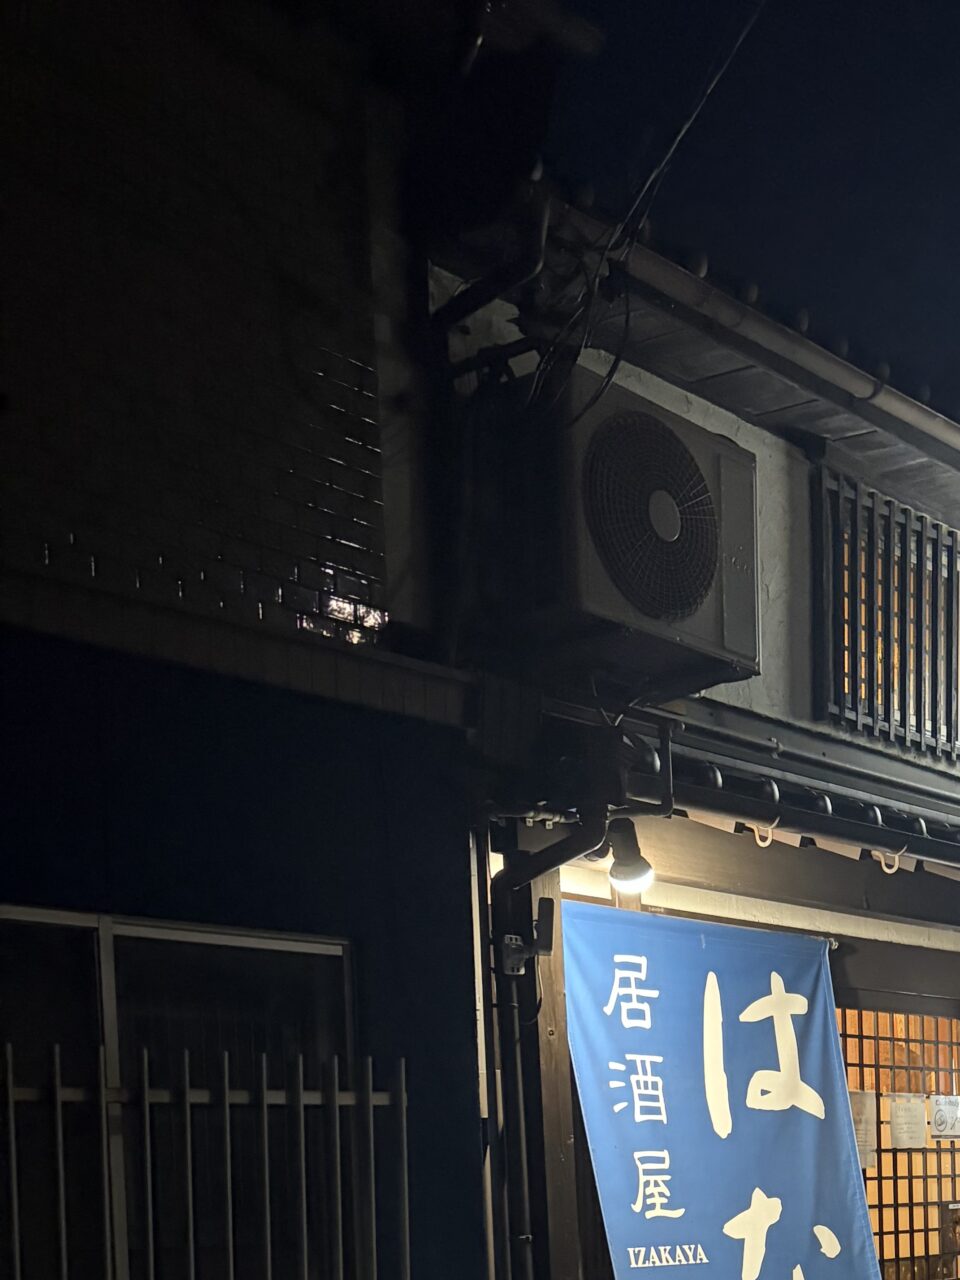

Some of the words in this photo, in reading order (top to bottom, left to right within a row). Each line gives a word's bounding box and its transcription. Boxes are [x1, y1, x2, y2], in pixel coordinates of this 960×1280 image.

[603, 954, 685, 1219] 居酒屋
[627, 1243, 710, 1268] IZAKAYA
